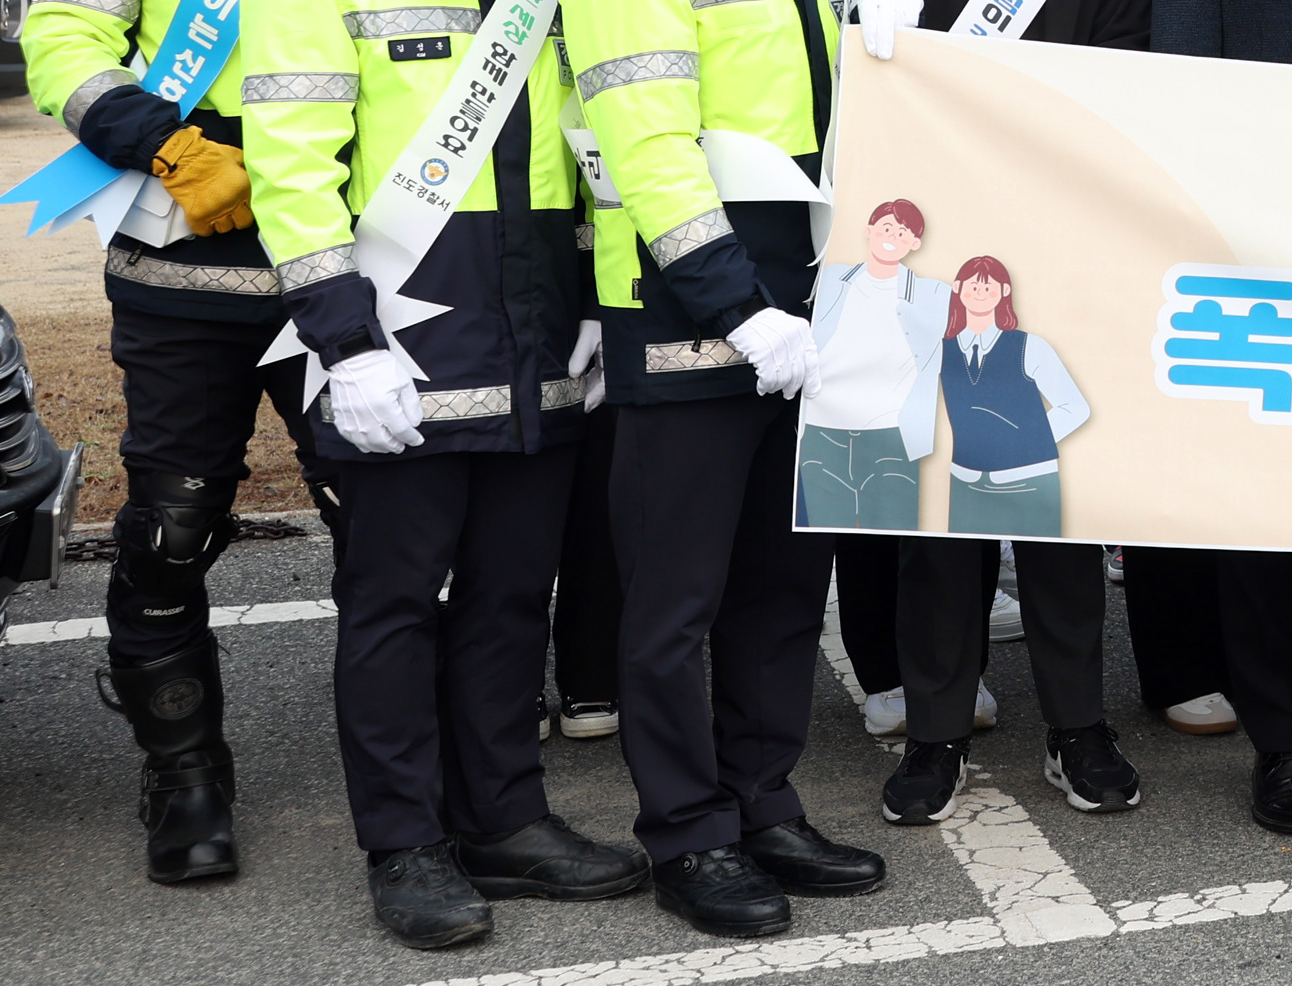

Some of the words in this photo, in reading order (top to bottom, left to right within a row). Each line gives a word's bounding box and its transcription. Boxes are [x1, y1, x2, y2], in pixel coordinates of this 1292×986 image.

[502, 4, 535, 45] 세상
[481, 41, 518, 87] 함께
[435, 80, 497, 159] 만들어요
[392, 172, 451, 212] 진도경찰서
